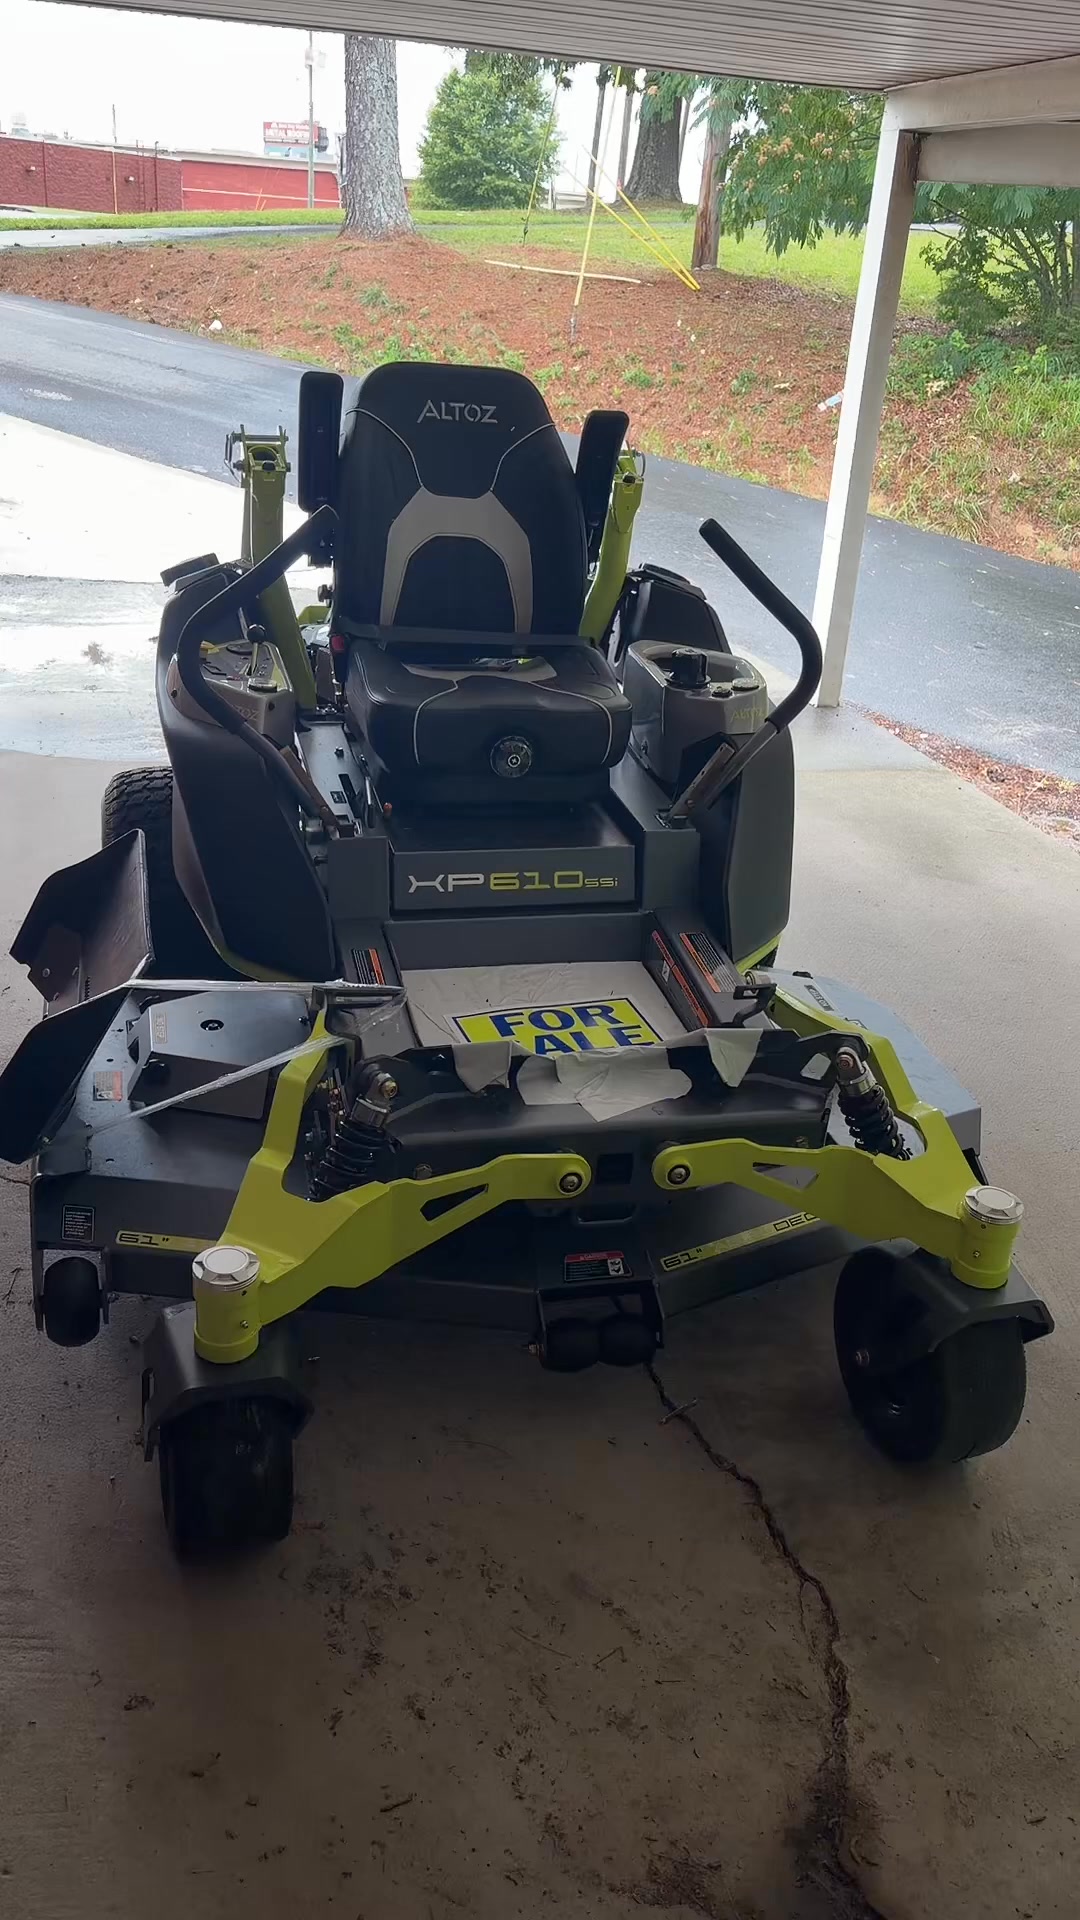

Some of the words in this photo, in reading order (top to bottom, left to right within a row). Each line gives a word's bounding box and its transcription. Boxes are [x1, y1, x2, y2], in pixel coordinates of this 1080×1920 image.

[416, 399, 499, 424] ALTOZ
[488, 1004, 624, 1038] FOR
[515, 1025, 655, 1056] ALE
